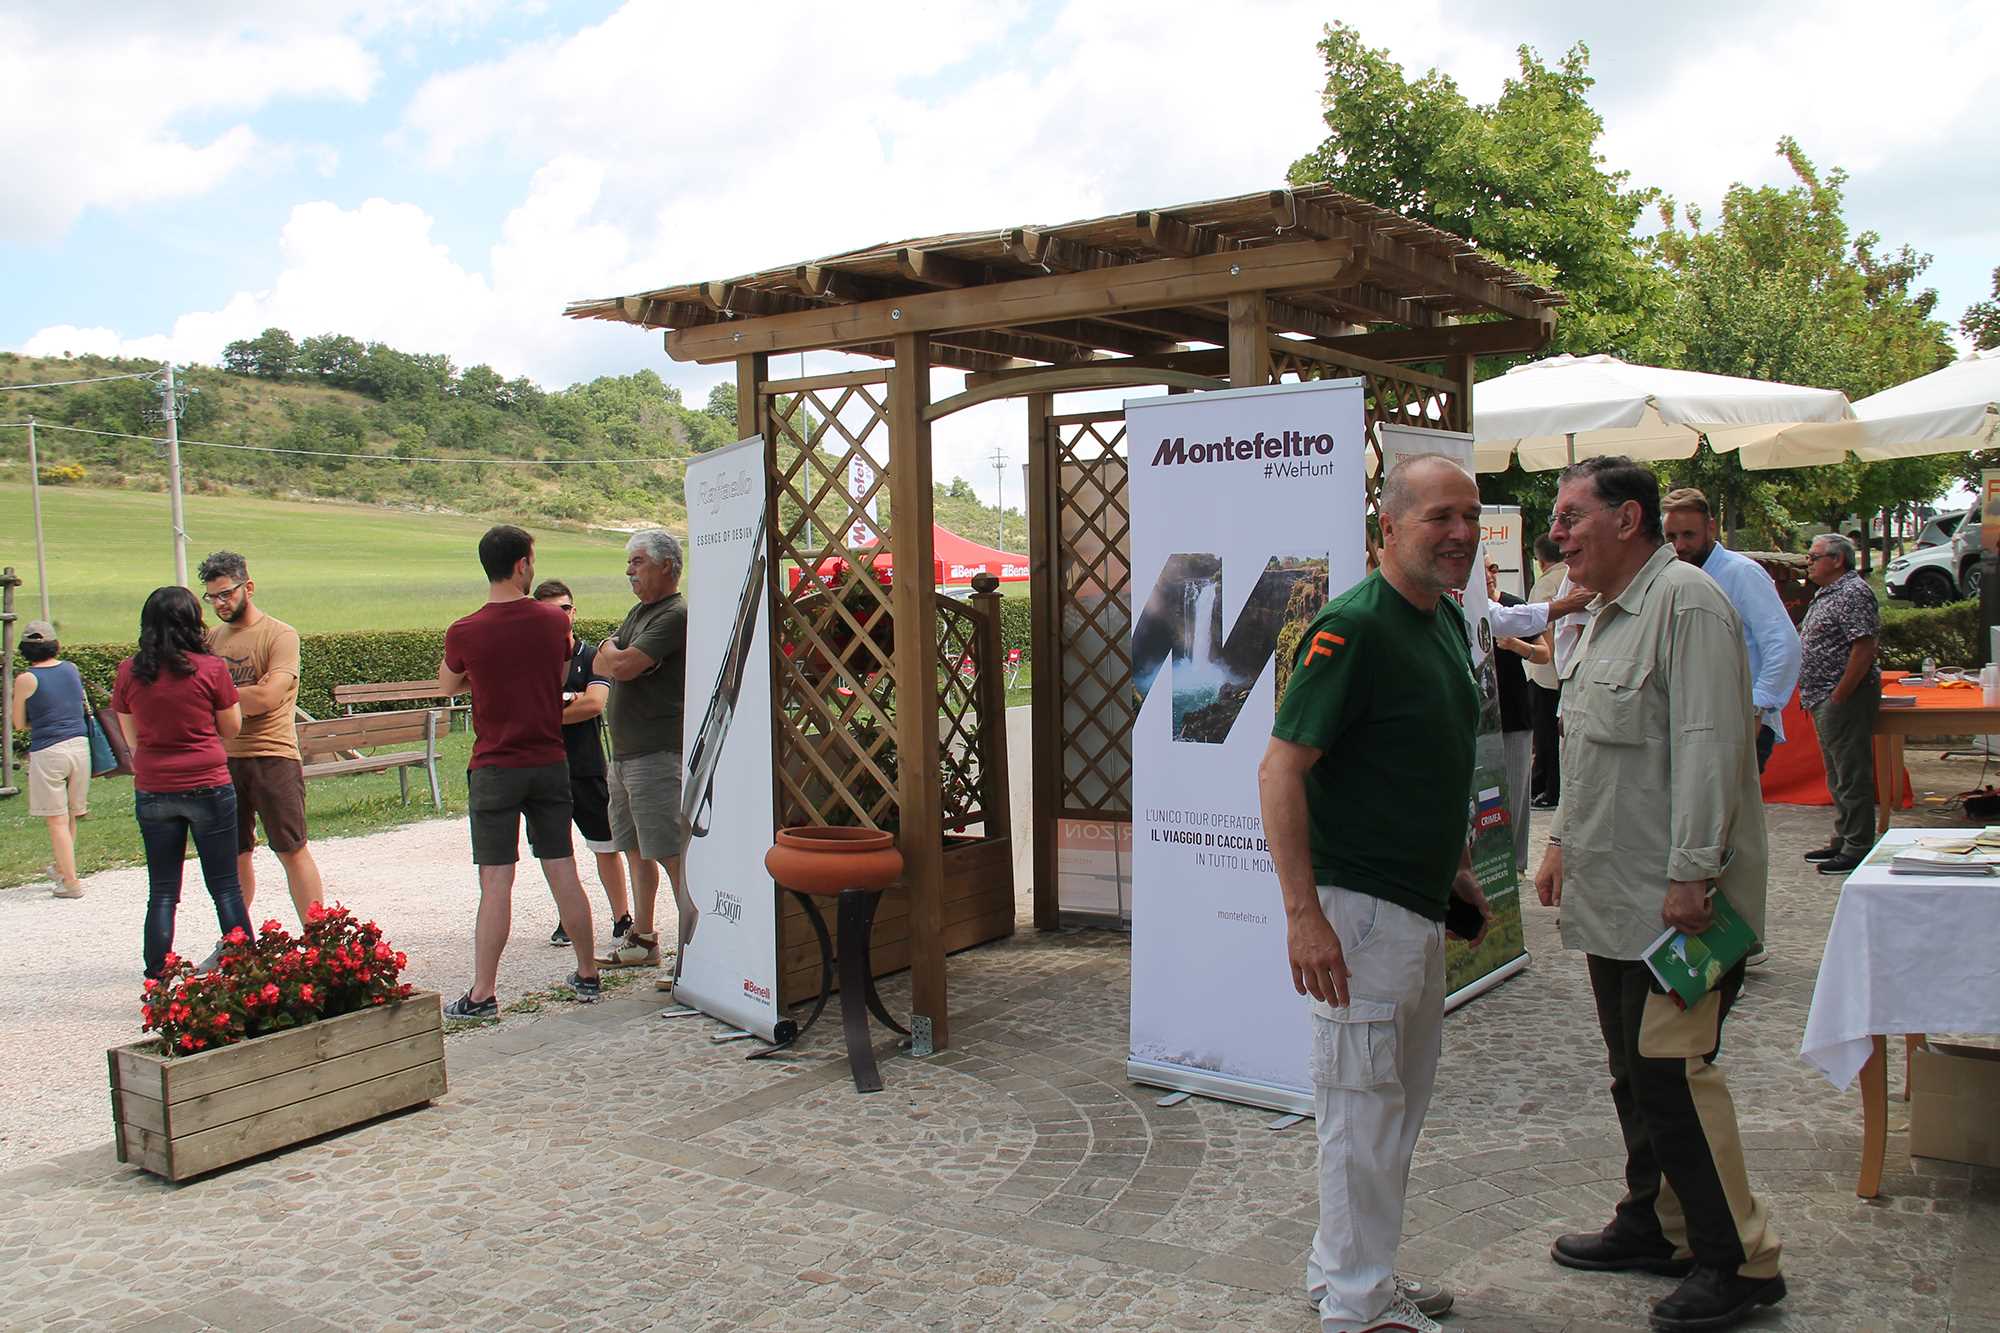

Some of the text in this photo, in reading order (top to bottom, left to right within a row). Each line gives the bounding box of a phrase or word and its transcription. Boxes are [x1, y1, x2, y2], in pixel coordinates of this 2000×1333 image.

[1152, 430, 1334, 466] Montefeltro
[1263, 460, 1334, 479] #WeHunt
[697, 527, 752, 546] ESSENCE OF DESIGN
[1146, 808, 1260, 830] L'UNICO TOUR OPERATOR
[1151, 829, 1161, 841] IL
[1163, 829, 1202, 846] VIAGGIO
[1205, 833, 1215, 846] DI
[1217, 834, 1253, 850] CACCIA
[1195, 852, 1206, 865] IN
[1208, 853, 1238, 870] TUTTO
[1240, 858, 1249, 871] IL
[1217, 910, 1267, 925] montefeltro.it
